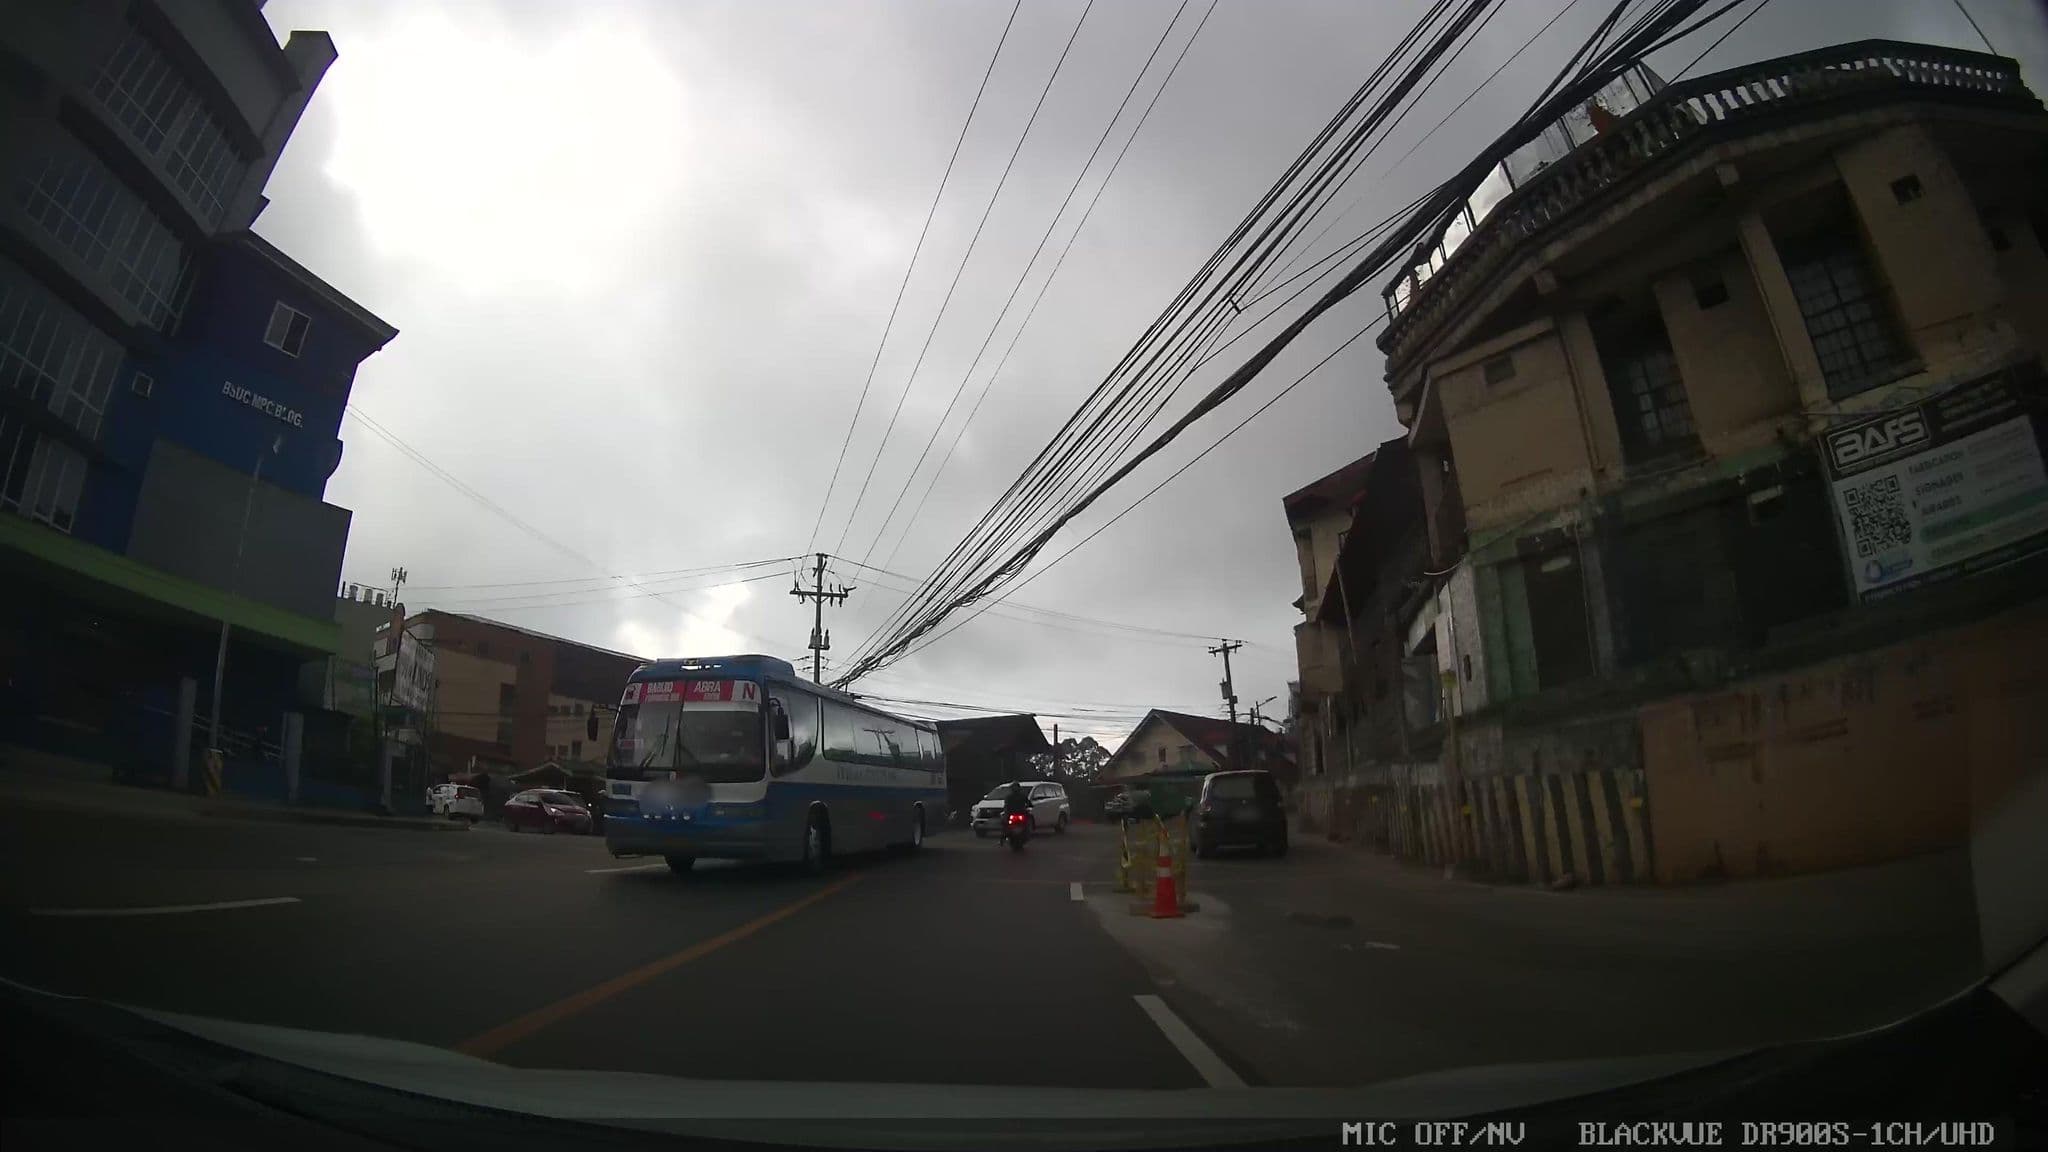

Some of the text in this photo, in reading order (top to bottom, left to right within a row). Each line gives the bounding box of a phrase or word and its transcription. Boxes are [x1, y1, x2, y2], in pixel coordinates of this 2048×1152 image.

[222, 380, 251, 404] BSUC
[251, 392, 275, 415] MPC
[1834, 409, 1926, 465] BAFS
[694, 680, 721, 693] ABRA
